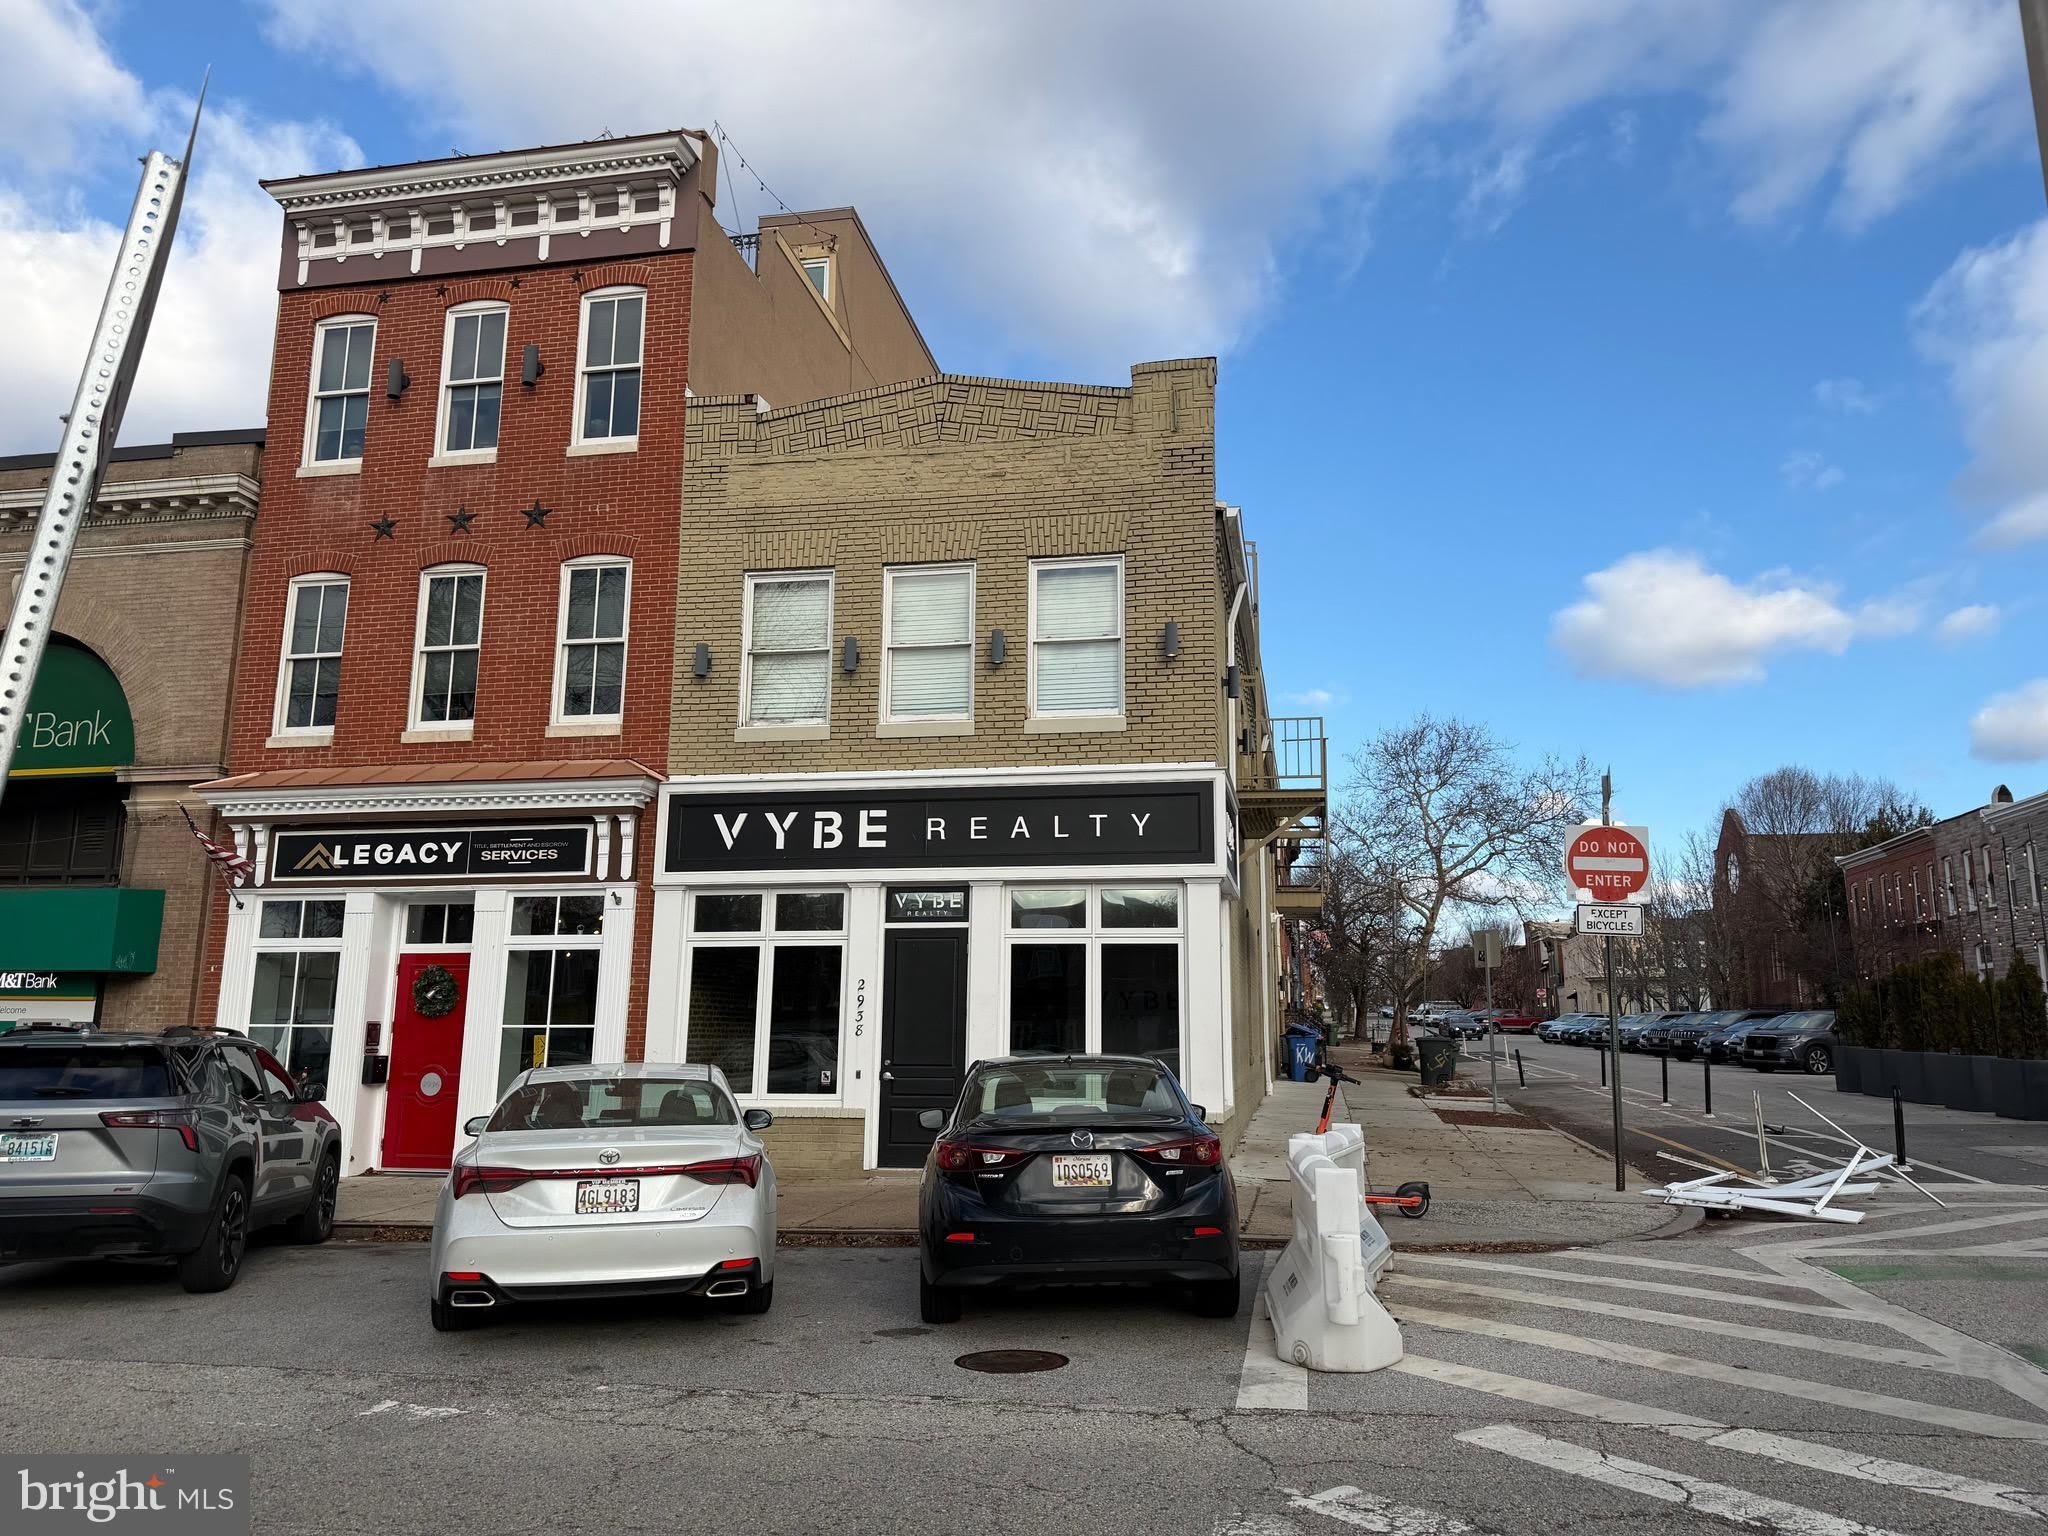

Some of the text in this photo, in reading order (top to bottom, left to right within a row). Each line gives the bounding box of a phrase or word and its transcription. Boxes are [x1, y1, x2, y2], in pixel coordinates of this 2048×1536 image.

[33, 710, 112, 748] Bank
[713, 809, 1151, 851] VYBE REALTY
[333, 841, 463, 865] LEGACY
[480, 849, 559, 861] SERVICES
[1579, 841, 1636, 854] DO NOT
[1585, 874, 1632, 887] ENTER
[895, 893, 962, 909] VYBE
[1591, 909, 1628, 919] EXCEPT
[1586, 920, 1634, 931] BICYCLES
[25, 972, 58, 989] Bank
[855, 979, 865, 1036] 2938
[552, 1166, 666, 1175] AVALON
[579, 1188, 637, 1206] 4GL9183
